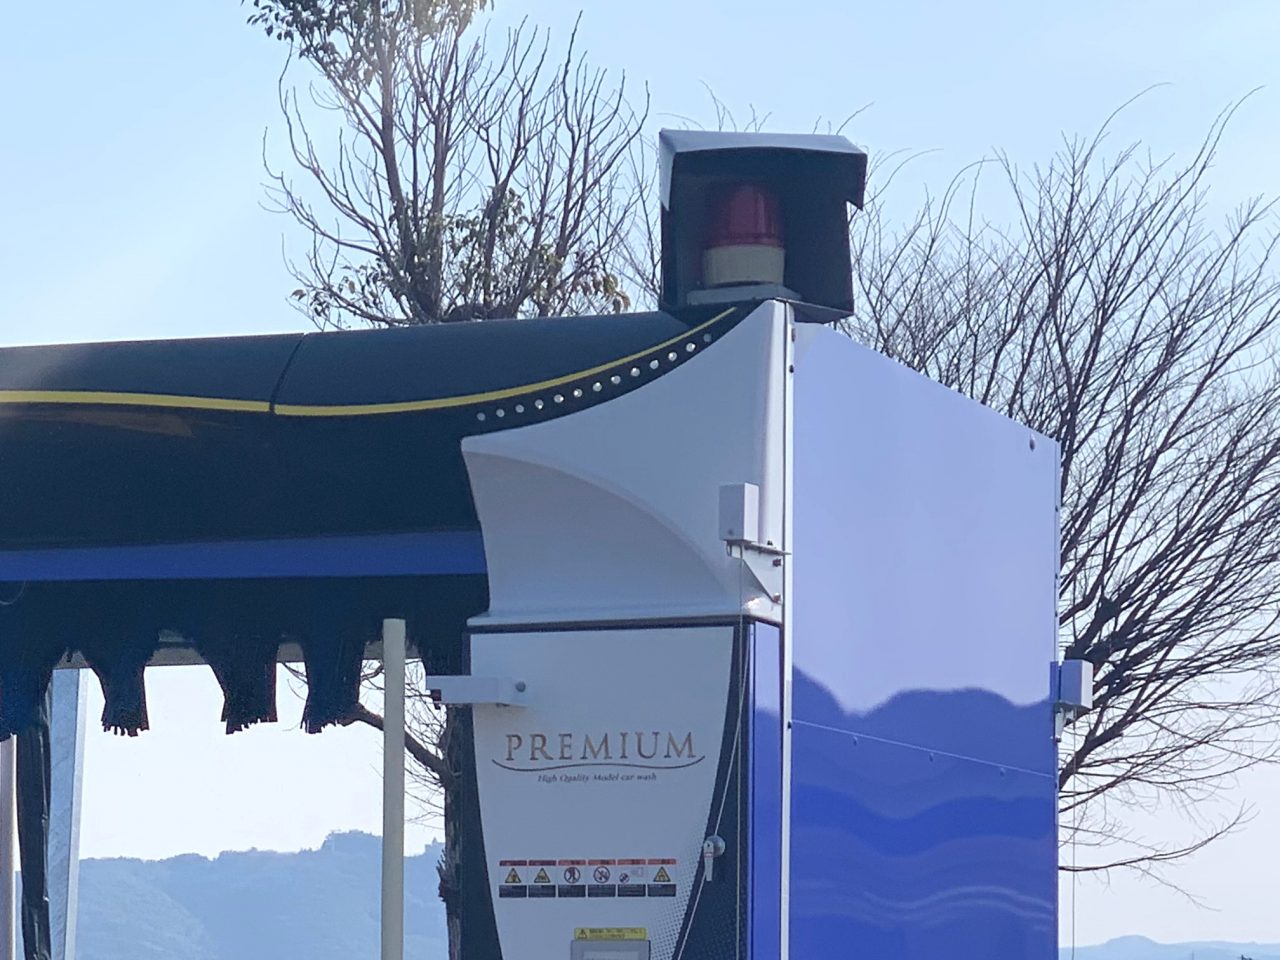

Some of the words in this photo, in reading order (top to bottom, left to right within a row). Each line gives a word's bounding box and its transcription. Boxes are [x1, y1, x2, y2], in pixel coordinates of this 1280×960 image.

[505, 731, 697, 761] PREMIUM
[537, 774, 557, 784] High
[637, 772, 657, 781] wash
